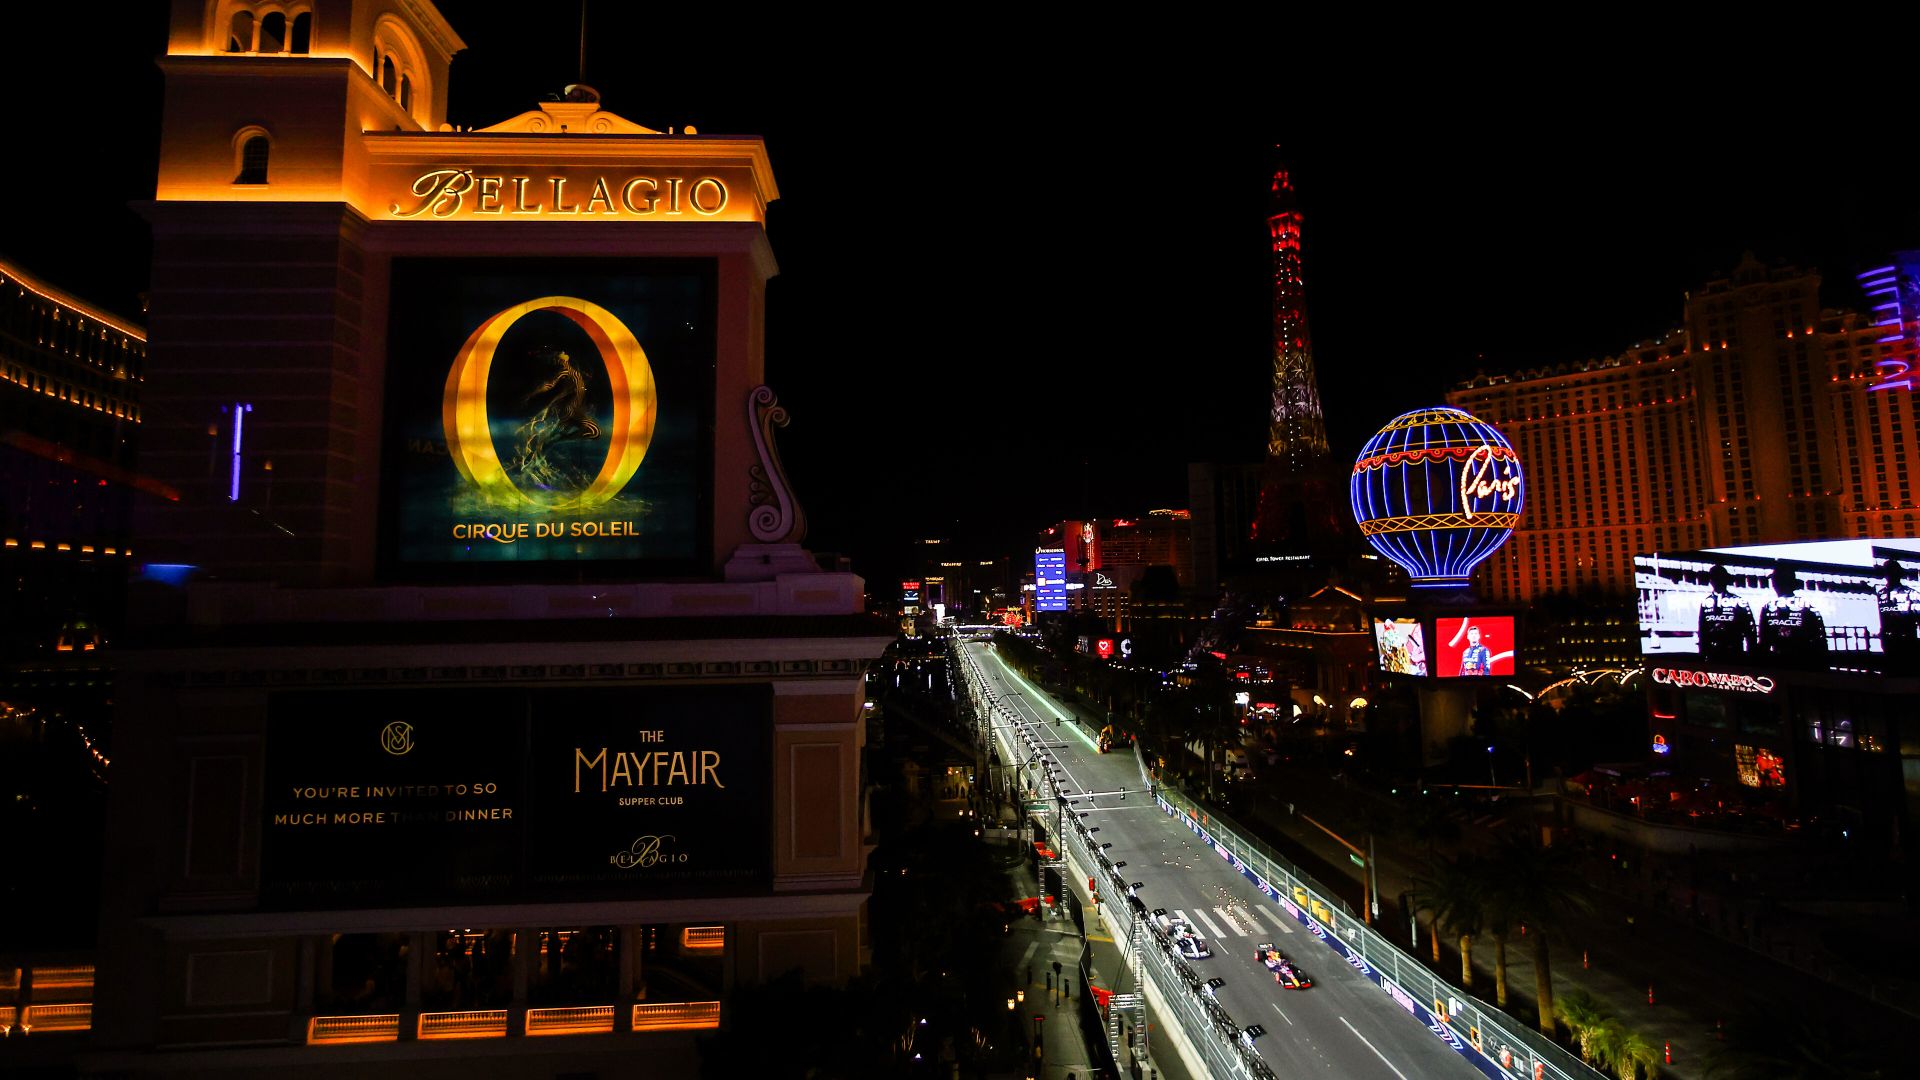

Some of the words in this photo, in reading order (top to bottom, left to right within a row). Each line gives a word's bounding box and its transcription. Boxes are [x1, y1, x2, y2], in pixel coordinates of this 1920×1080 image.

[389, 168, 729, 219] BELLAGIO
[1461, 444, 1520, 520] Paris
[452, 522, 529, 544] CIRQUE
[535, 522, 565, 537] DU
[570, 521, 640, 538] SOLEIL
[1768, 619, 1803, 627] ORACLE
[1652, 667, 1709, 688] CABO
[639, 730, 665, 743] THE
[574, 747, 726, 793] MAYFAIR
[292, 786, 361, 799] YOU'RE
[366, 785, 440, 798] INVITED
[444, 783, 468, 796] TO
[473, 782, 497, 795] SO
[618, 797, 656, 806] SUPPER
[658, 796, 685, 806] CLUB
[273, 813, 328, 826] MUCH
[333, 811, 386, 825] MORE
[445, 807, 513, 822] DINNER
